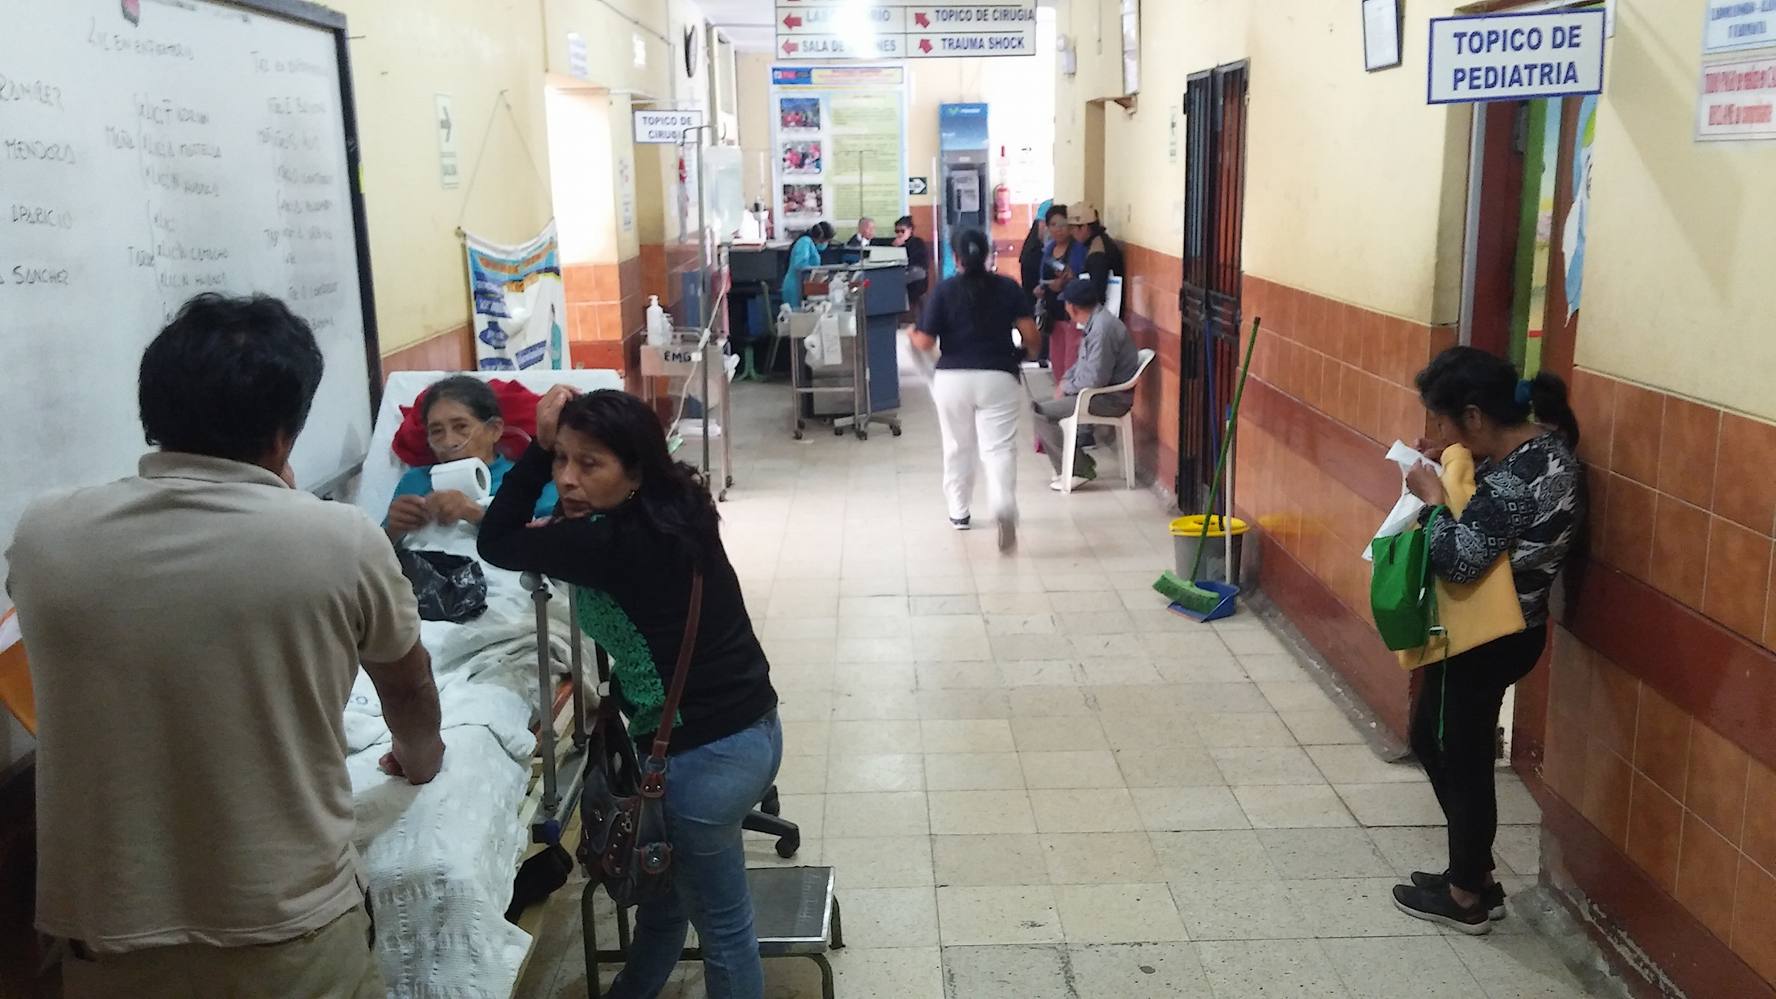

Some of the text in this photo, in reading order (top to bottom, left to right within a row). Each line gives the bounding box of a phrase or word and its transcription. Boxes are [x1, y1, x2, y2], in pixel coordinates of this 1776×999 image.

[935, 9, 1035, 21] TOPICO DE CIRUGIA
[802, 39, 828, 52] SALA
[941, 36, 1025, 50] TRAUMA SHOCK
[1453, 25, 1582, 55] TOPICO DE
[1453, 61, 1579, 91] PEDIATRIA
[642, 116, 693, 126] TOPICO DE
